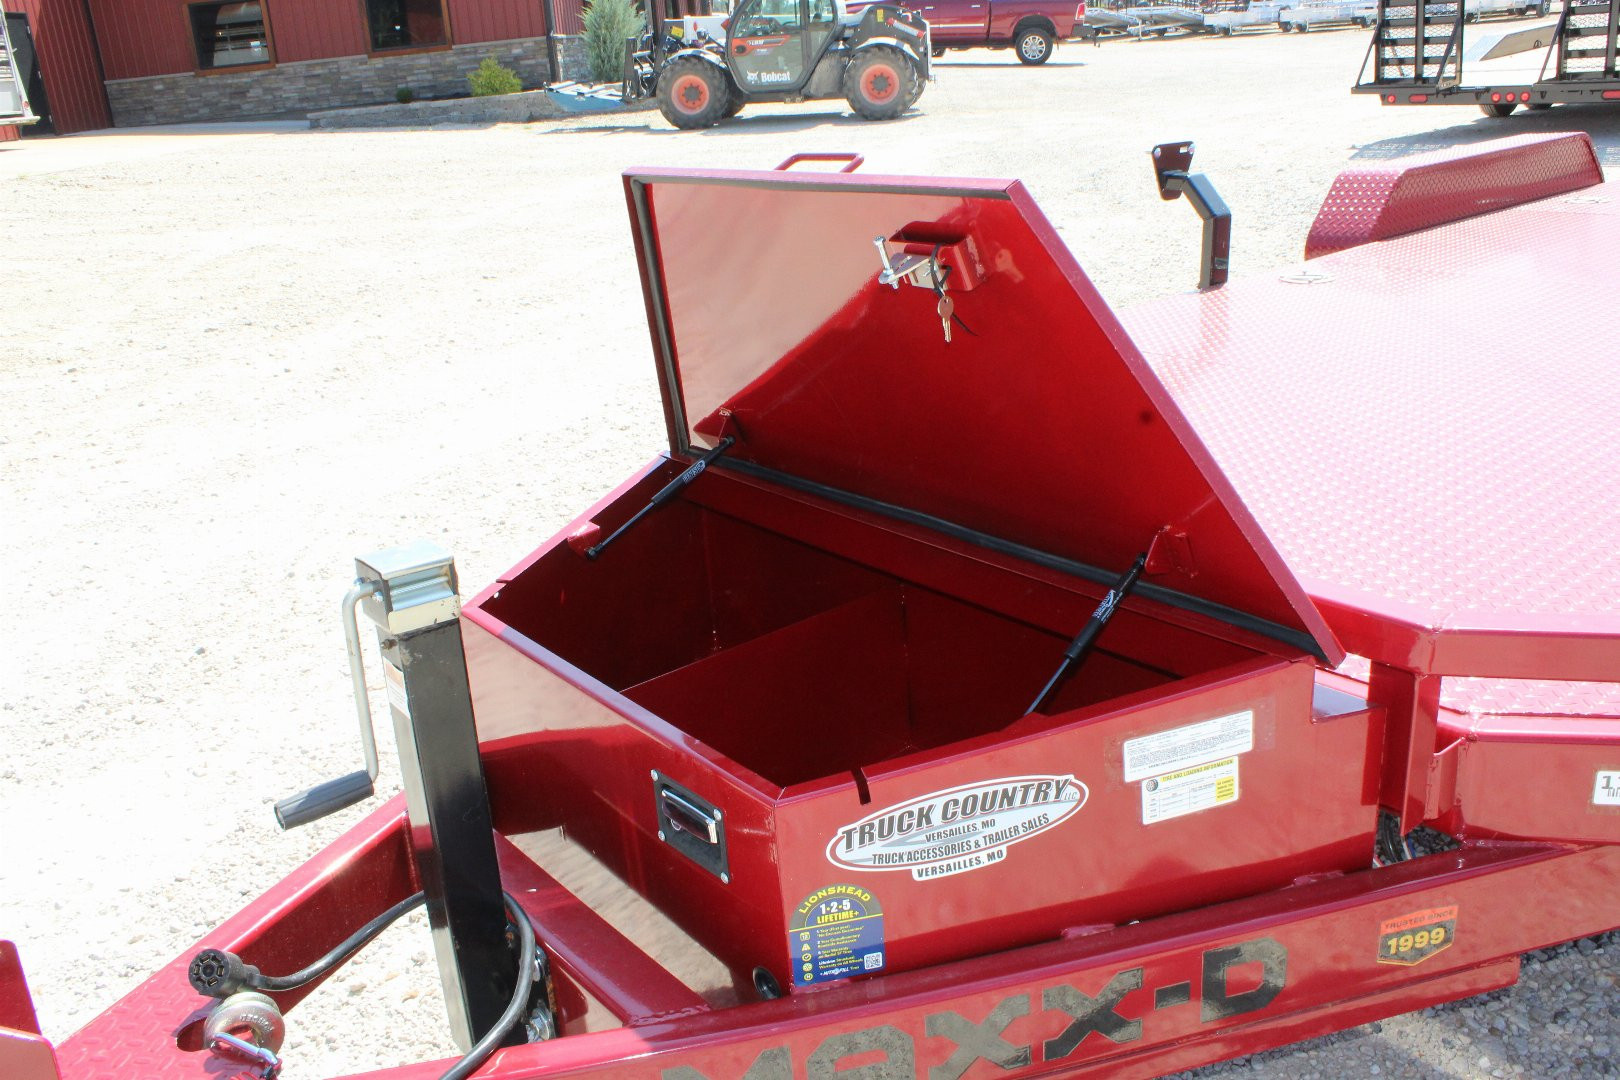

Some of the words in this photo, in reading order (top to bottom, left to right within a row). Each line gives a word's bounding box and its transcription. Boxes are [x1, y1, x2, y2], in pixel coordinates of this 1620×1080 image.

[761, 71, 790, 82] Bobcat
[841, 803, 937, 852] TRUCK
[941, 778, 1073, 823] COUNTRY
[872, 852, 904, 864] TRUCK
[904, 840, 972, 862] ACCESSORIES
[974, 839, 981, 849] &
[982, 825, 1020, 847] TRAILER
[1021, 813, 1050, 833] SALES
[925, 822, 980, 842] VERSAILLES,
[981, 818, 996, 830] MO
[917, 856, 985, 877] VERSAILLES,
[986, 849, 1004, 862] MO
[798, 886, 871, 913] LIONSHEAD
[816, 910, 859, 923] LIFETIME+
[1387, 927, 1445, 955] 1999
